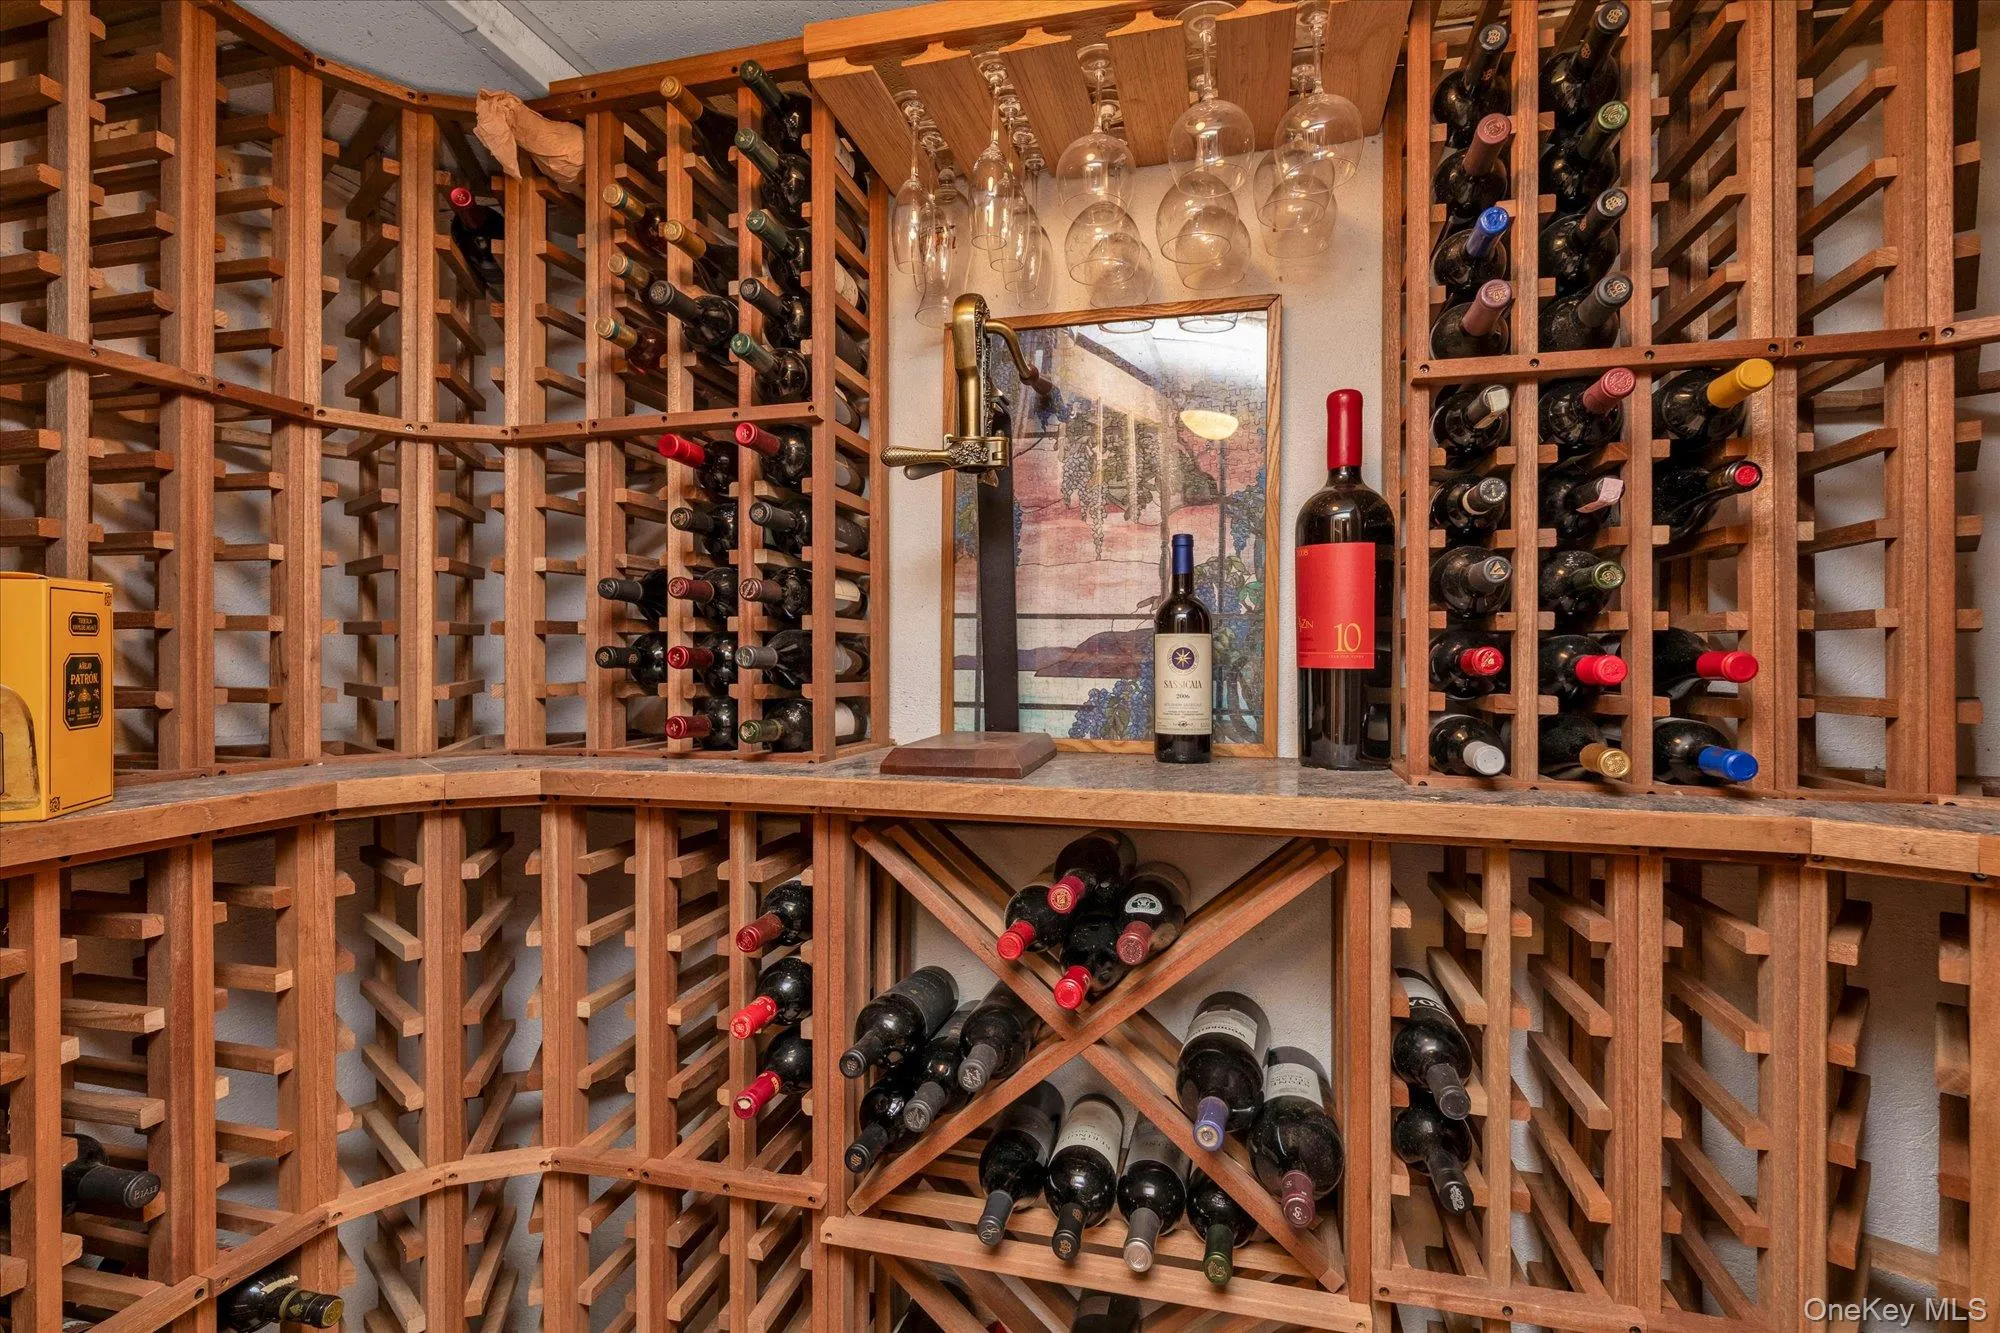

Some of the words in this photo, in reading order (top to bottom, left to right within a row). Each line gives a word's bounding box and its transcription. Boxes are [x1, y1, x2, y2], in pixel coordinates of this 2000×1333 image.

[1333, 622, 1362, 652] 10
[70, 671, 98, 685] PATRÓN
[1163, 680, 1203, 689] SASSICAIA
[134, 1185, 159, 1200] BIALE
